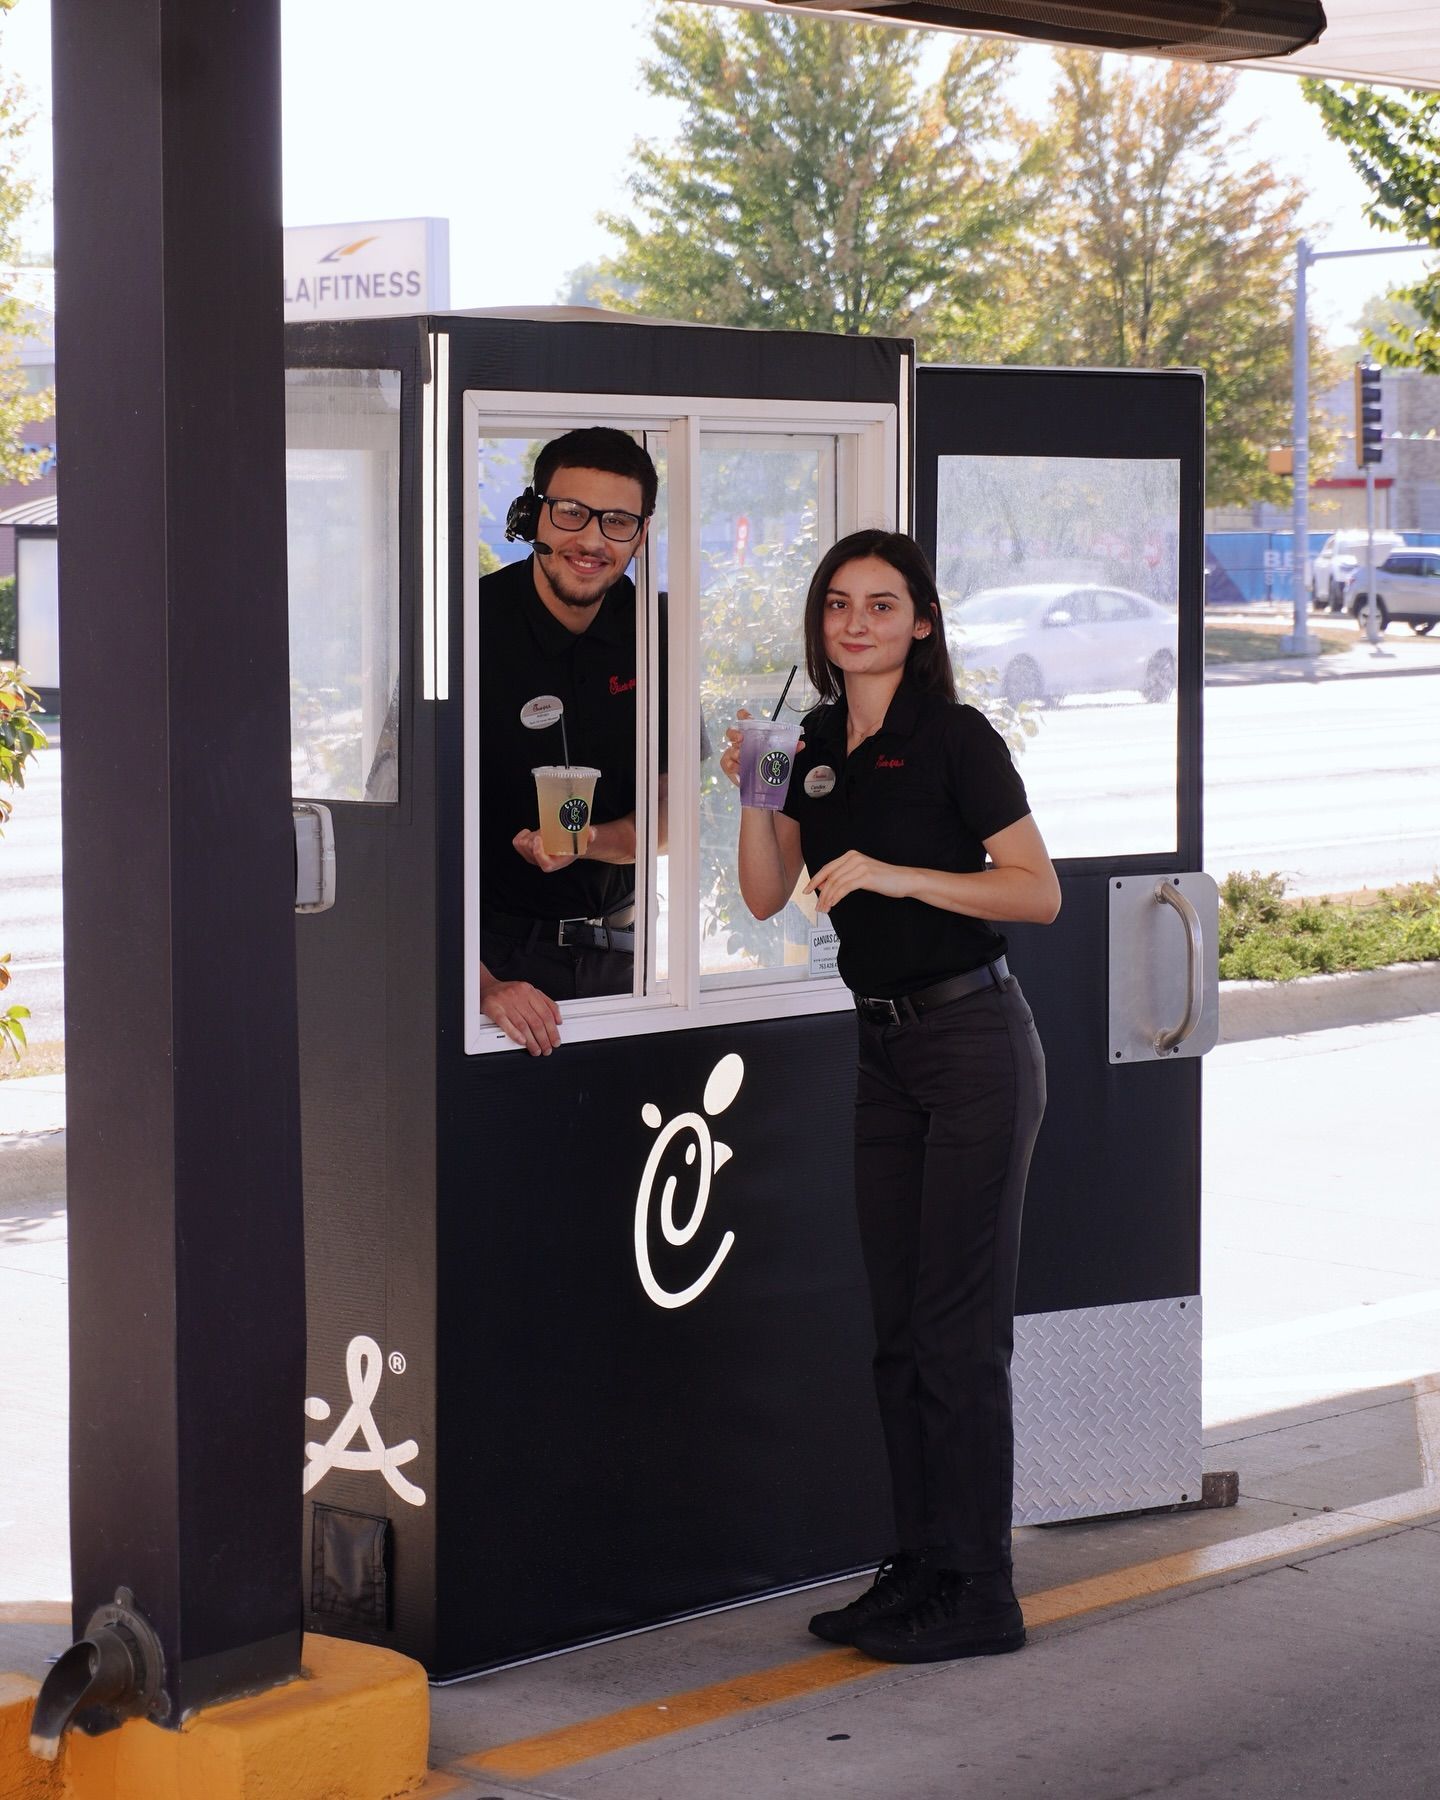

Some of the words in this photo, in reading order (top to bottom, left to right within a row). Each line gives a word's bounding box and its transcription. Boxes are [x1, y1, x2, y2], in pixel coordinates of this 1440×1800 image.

[284, 277, 311, 303] LA
[319, 270, 421, 301] FITNESS
[1263, 551, 1297, 568] BE
[813, 934, 833, 947] CANVAS
